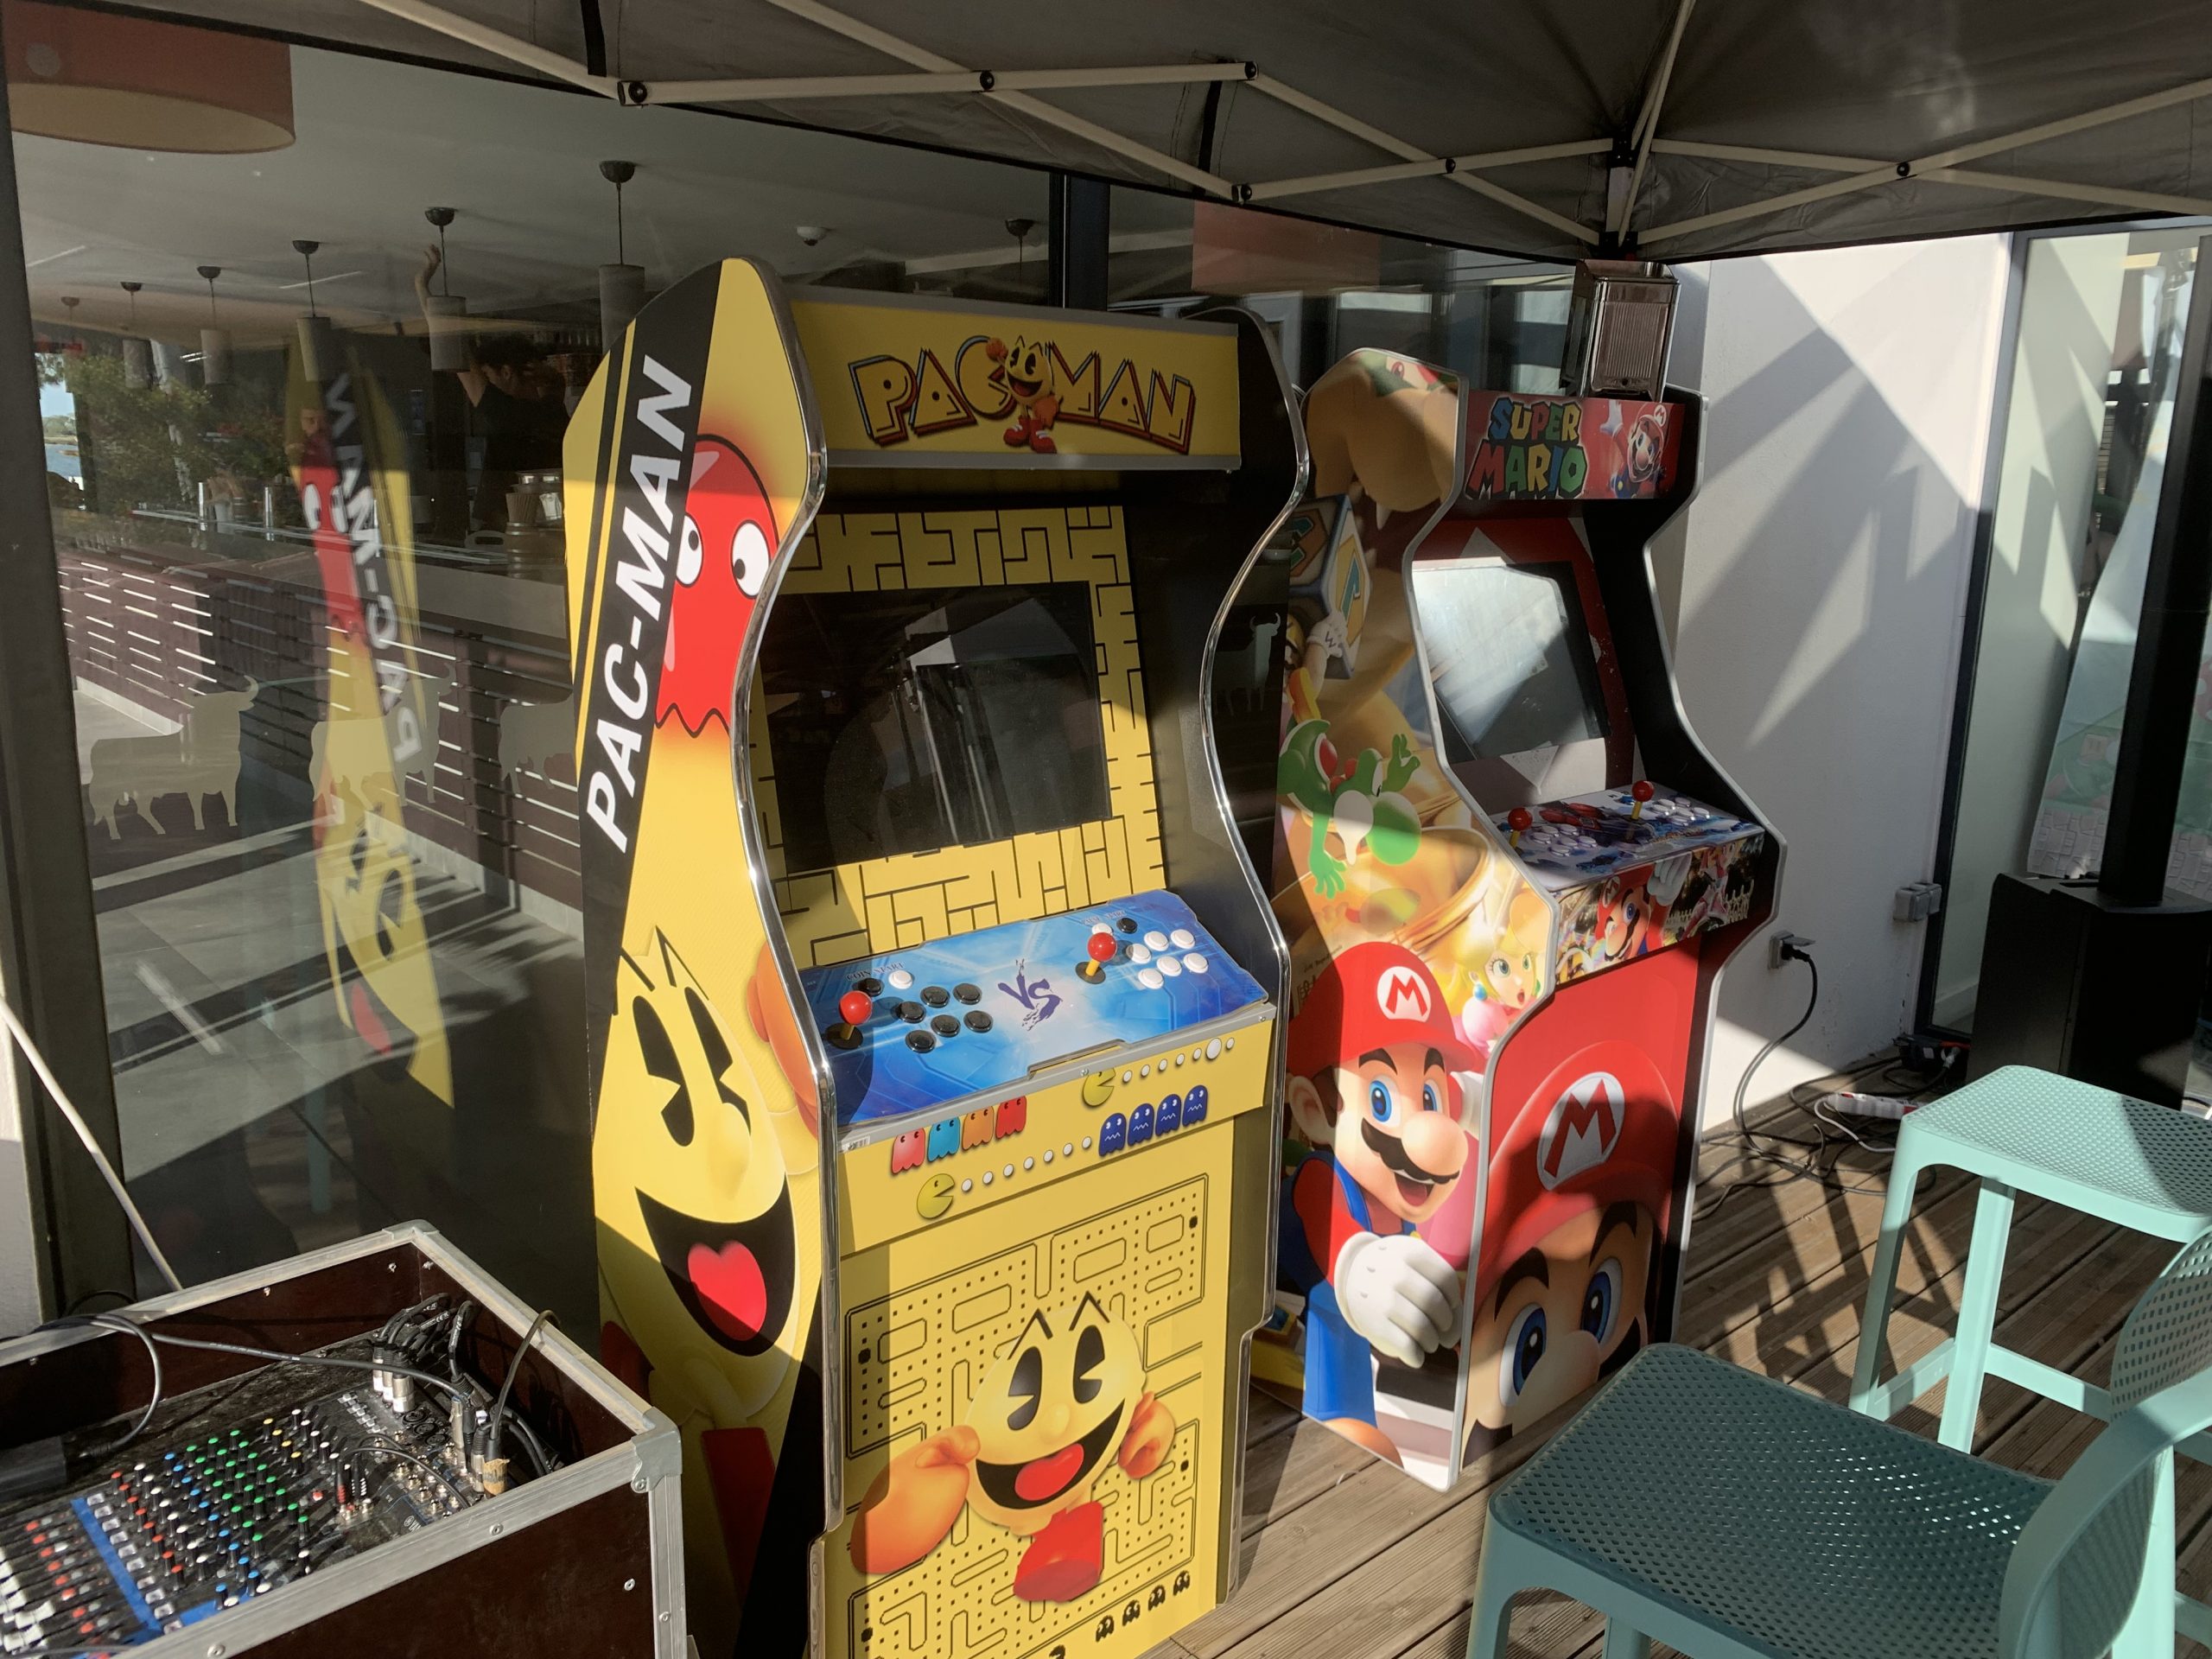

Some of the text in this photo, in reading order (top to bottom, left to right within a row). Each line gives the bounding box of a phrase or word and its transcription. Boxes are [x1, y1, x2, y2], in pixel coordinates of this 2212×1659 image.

[1487, 397, 1582, 442] SUPER
[1465, 439, 1588, 499] MARIO
[586, 354, 692, 855] PAC-MAN
[997, 958, 1065, 1032] VS
[1385, 973, 1429, 1017] M
[1543, 1077, 1618, 1179] M
